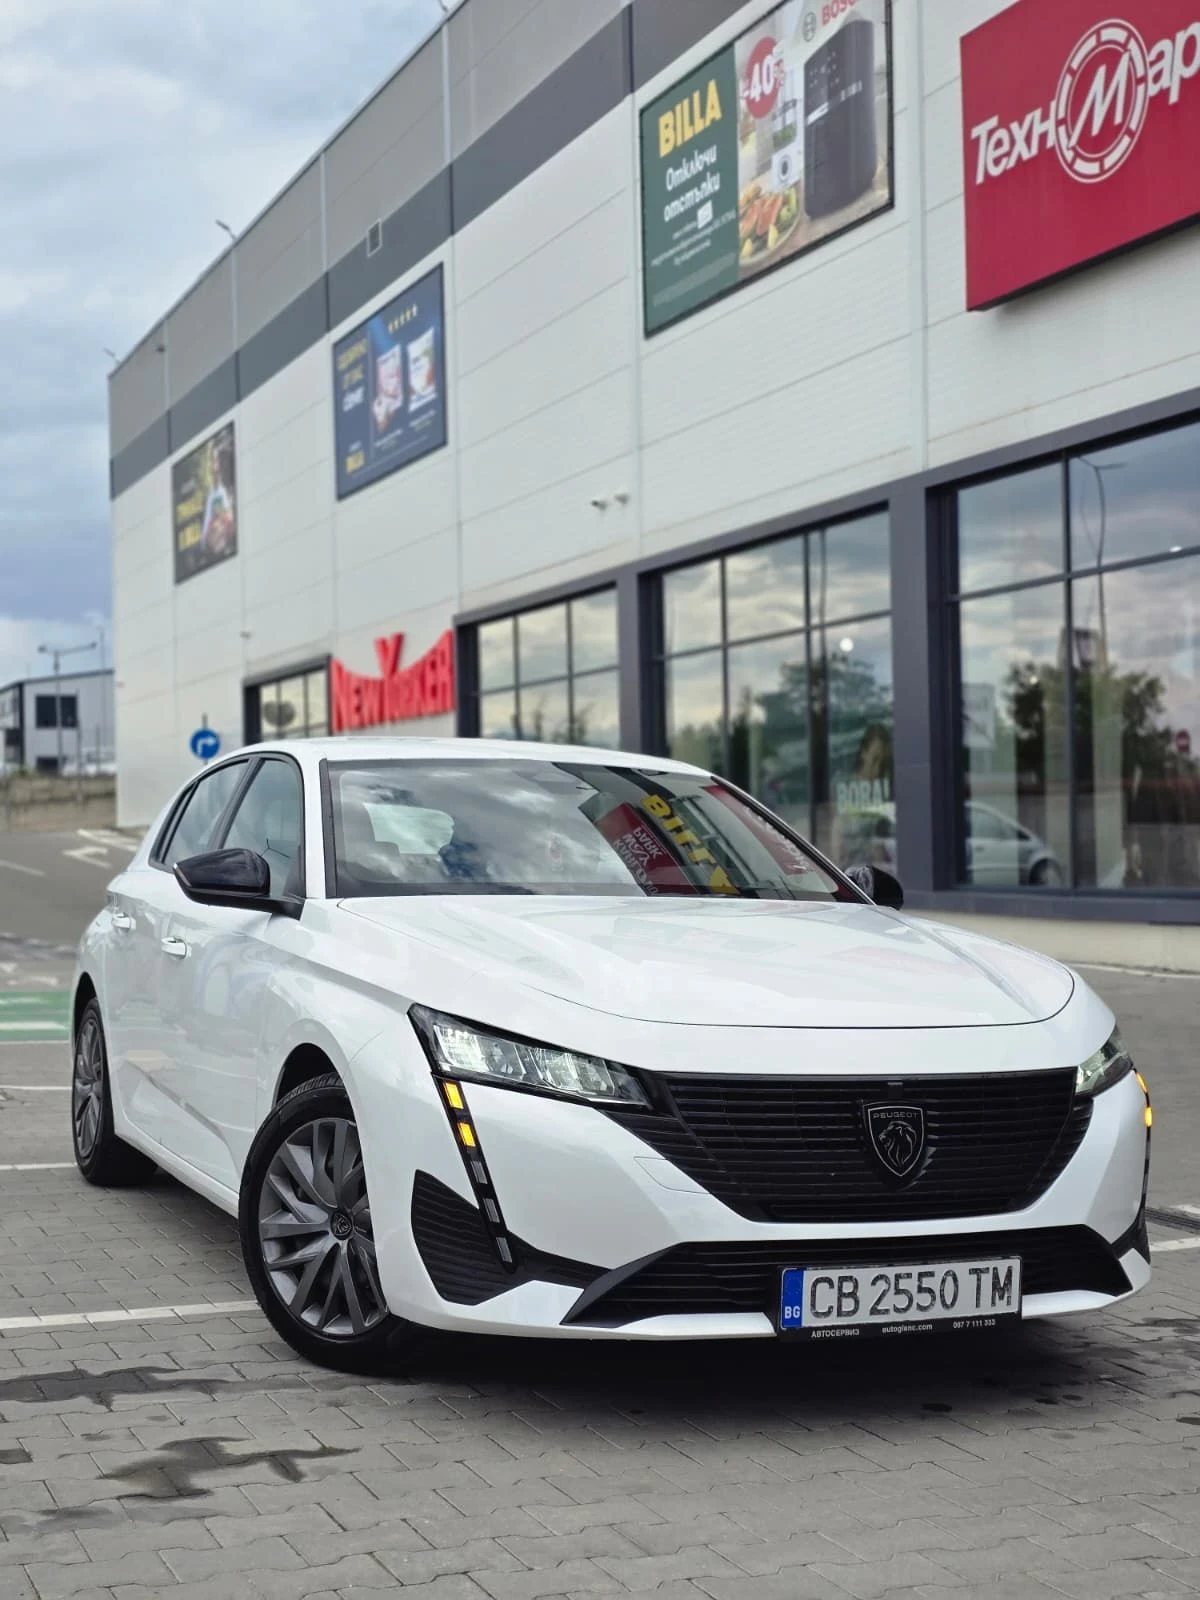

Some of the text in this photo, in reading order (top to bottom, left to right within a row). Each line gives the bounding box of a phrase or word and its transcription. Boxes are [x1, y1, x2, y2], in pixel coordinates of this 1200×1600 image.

[658, 79, 722, 158] BILLA
[873, 1111, 919, 1119] PEUGEOT
[869, 1269, 959, 1316] 2550
[784, 1306, 801, 1319] BG
[811, 1329, 860, 1338] АВТОСЕРВИЗ
